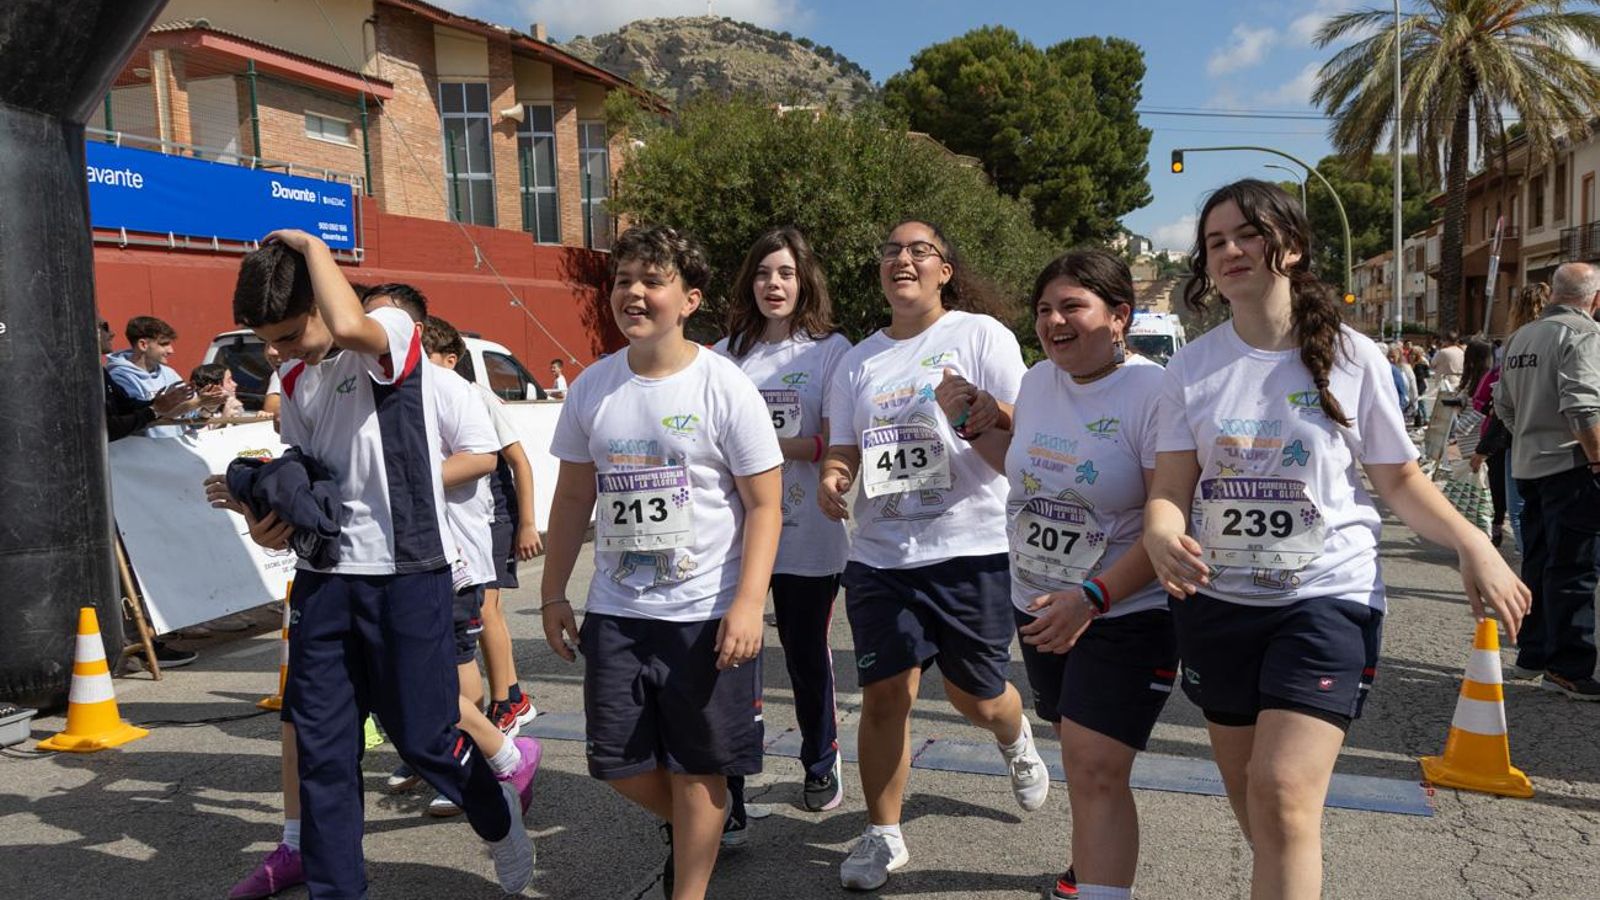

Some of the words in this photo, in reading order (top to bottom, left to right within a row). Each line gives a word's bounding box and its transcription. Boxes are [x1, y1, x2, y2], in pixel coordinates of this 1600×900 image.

[271, 180, 316, 203] Davante
[876, 447, 928, 471] 413
[1263, 489, 1273, 498] LA
[612, 497, 668, 525] 213
[1222, 508, 1294, 539] 239
[1026, 521, 1081, 555] 207
